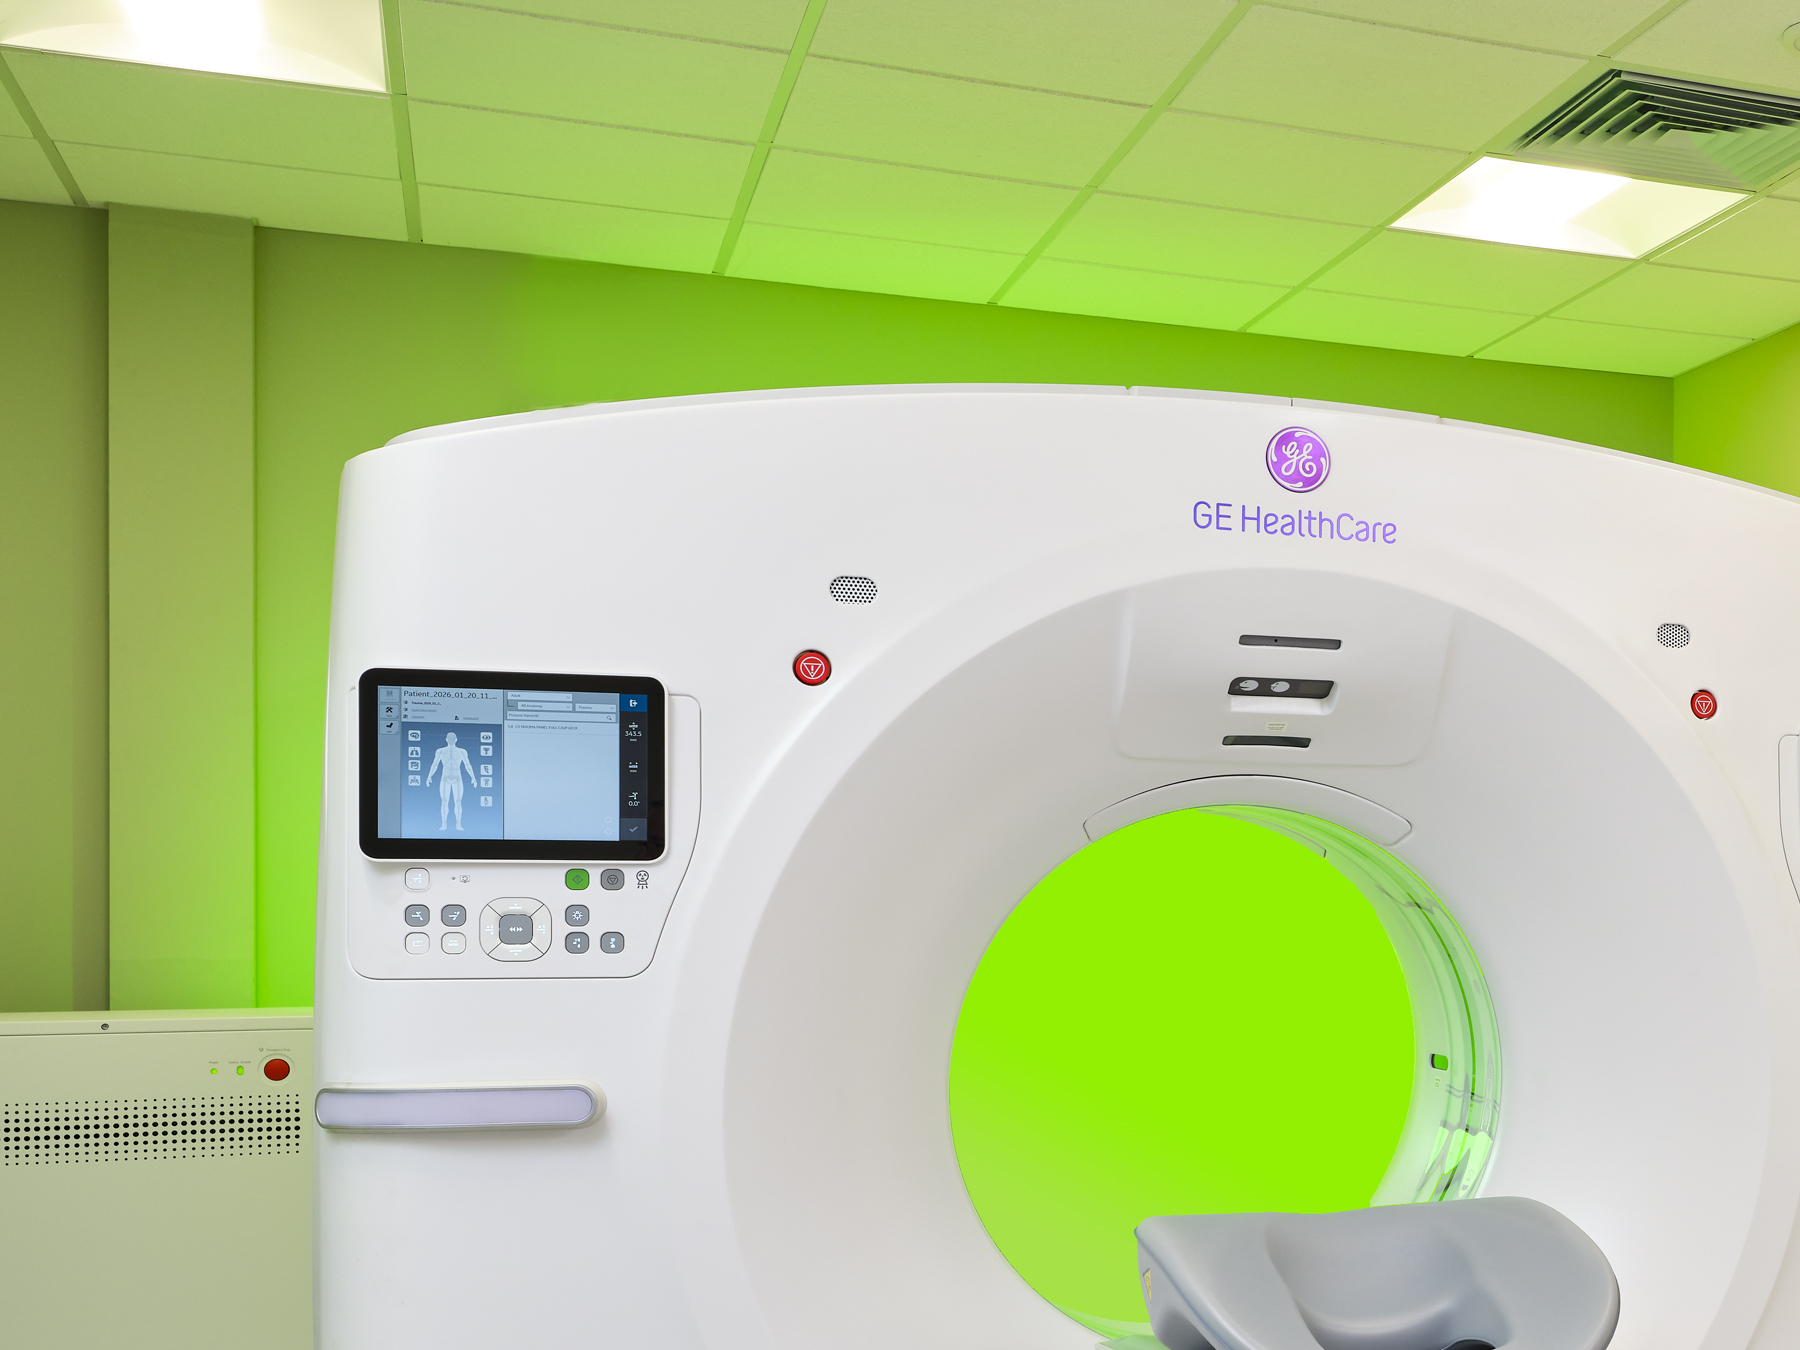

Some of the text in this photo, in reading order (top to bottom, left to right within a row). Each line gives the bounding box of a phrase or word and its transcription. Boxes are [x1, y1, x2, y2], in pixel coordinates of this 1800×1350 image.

[1281, 441, 1317, 477] GE
[1193, 501, 1398, 544] GE HealthCare
